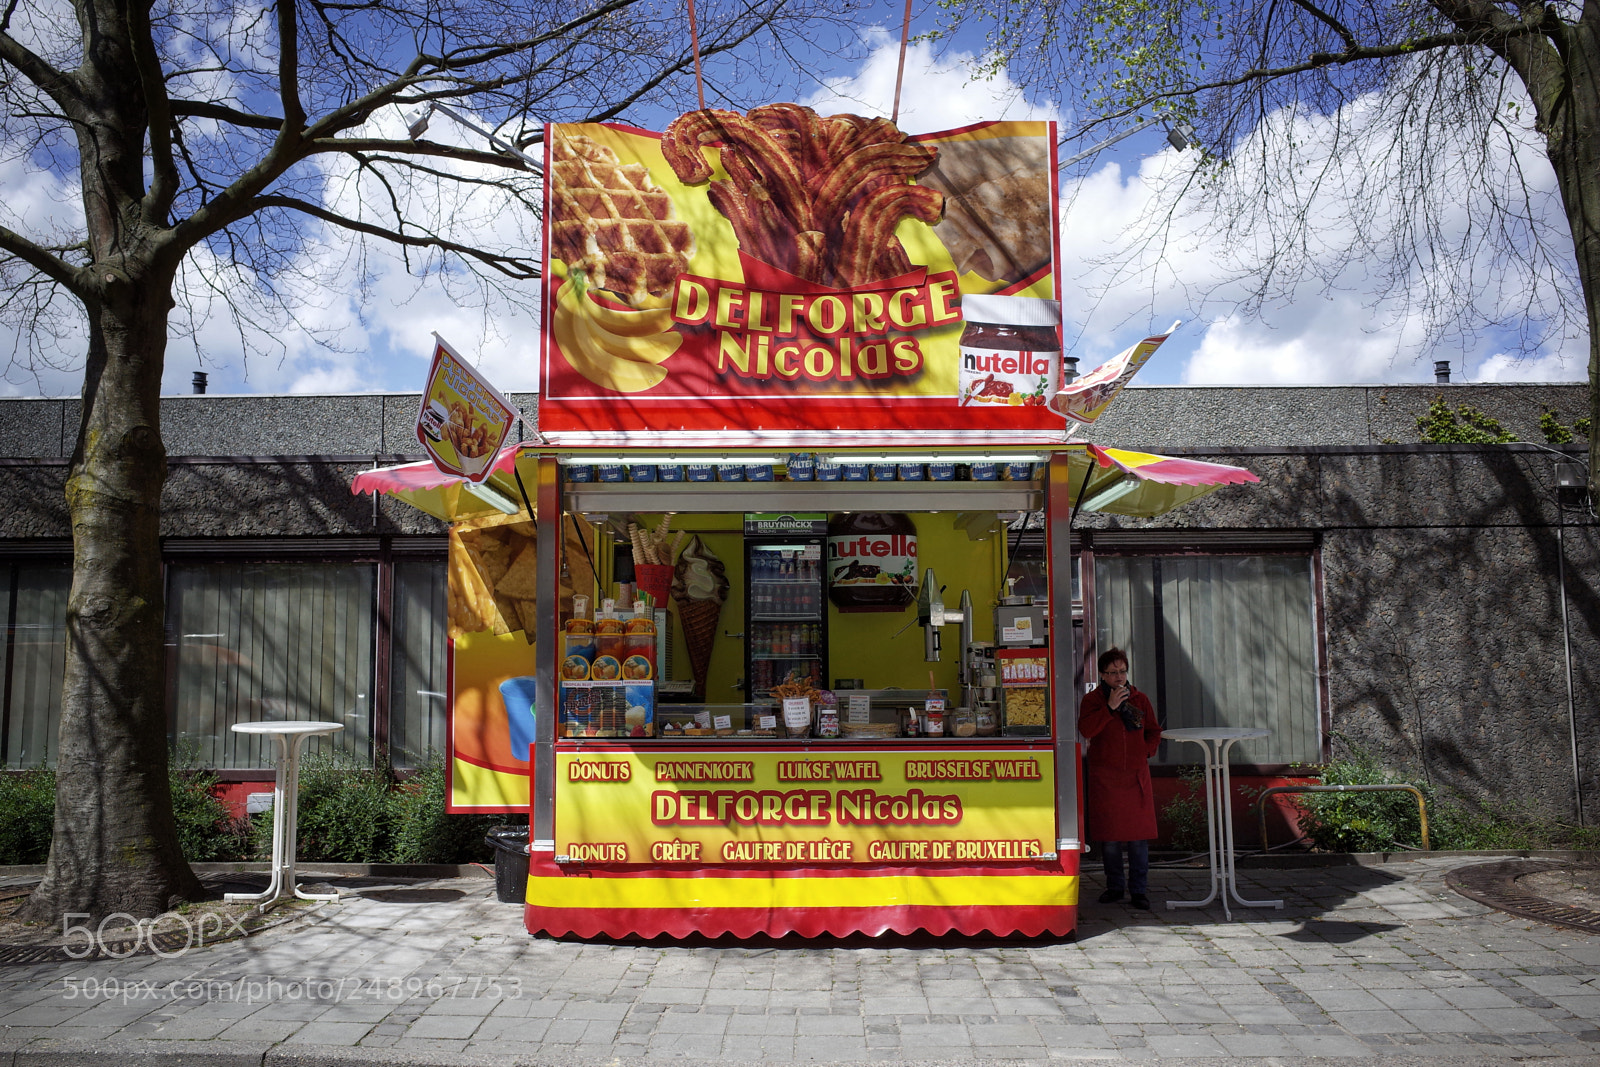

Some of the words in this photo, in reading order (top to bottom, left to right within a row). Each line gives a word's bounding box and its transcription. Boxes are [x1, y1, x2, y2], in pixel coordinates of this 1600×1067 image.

[675, 279, 959, 334] DELFORGE
[718, 331, 919, 377] Nicolas
[964, 351, 1050, 375] nutella
[440, 351, 509, 421] DELFORGE
[442, 369, 499, 425] NICOLAS
[828, 534, 917, 557] nutella
[570, 763, 630, 779] DONUTS
[656, 763, 752, 779] PANNENKOEK
[779, 762, 831, 779] LUIKSE
[834, 762, 880, 779] WAFEL
[907, 762, 990, 778] BRUSSELSE
[994, 762, 1040, 778] WAFEL
[656, 794, 827, 821] DELFORGE
[841, 793, 959, 820] Nicolas
[569, 844, 626, 860] DONUTS
[652, 839, 700, 860] CRÊPE
[723, 843, 782, 860] GAUFRE
[786, 843, 805, 860] DE
[810, 839, 851, 860] LIÈGE
[869, 842, 928, 860] GAUFRE
[932, 842, 951, 860] DE
[956, 841, 1041, 859] BRUXELLES
